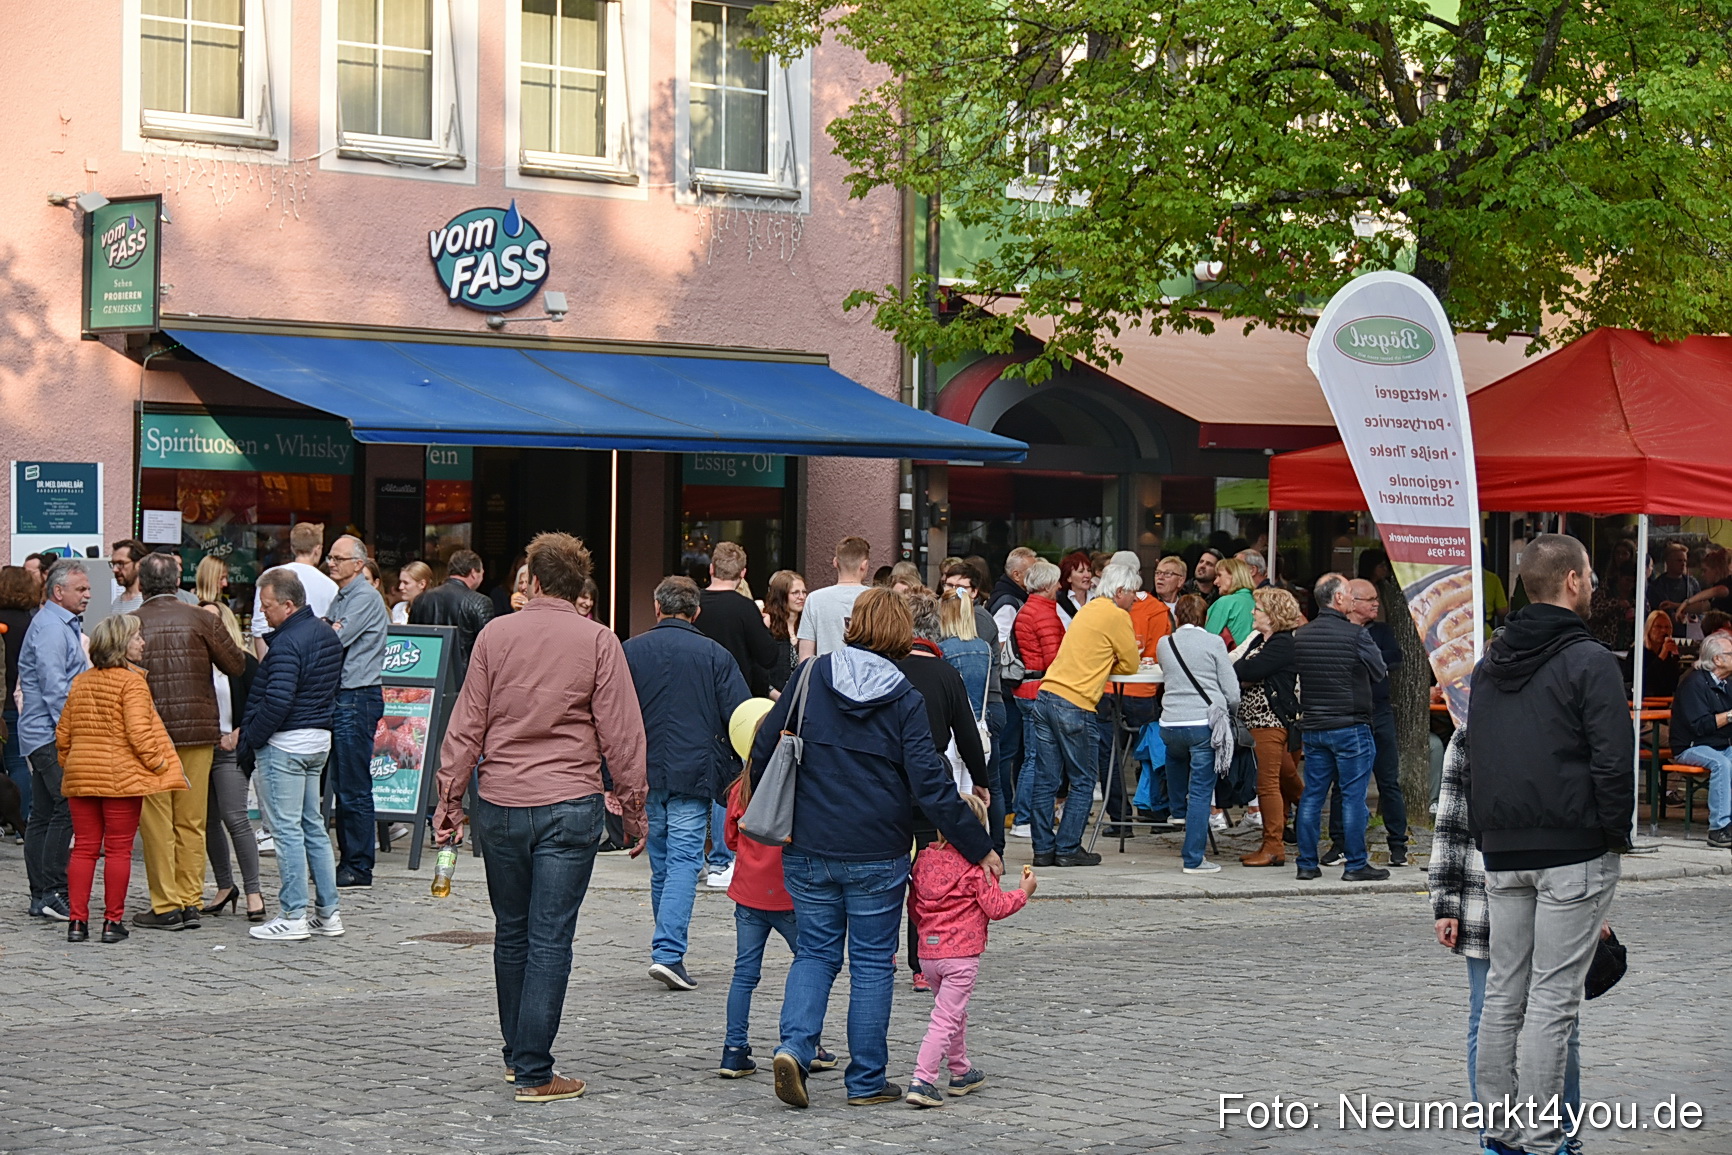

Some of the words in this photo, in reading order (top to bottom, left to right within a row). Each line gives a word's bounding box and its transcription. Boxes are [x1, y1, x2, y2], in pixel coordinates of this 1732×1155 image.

[101, 222, 126, 248] vom
[430, 218, 495, 258] vom
[108, 228, 147, 267] FASS
[450, 240, 548, 298] FASS
[104, 291, 142, 300] PROBIEREN
[103, 304, 142, 314] GENIESSEN
[146, 428, 258, 458] Spirituosen
[276, 434, 350, 464] Whisky
[426, 446, 458, 464] ein
[694, 454, 737, 477] Essig
[200, 538, 218, 550] vom
[382, 648, 421, 670] FASS
